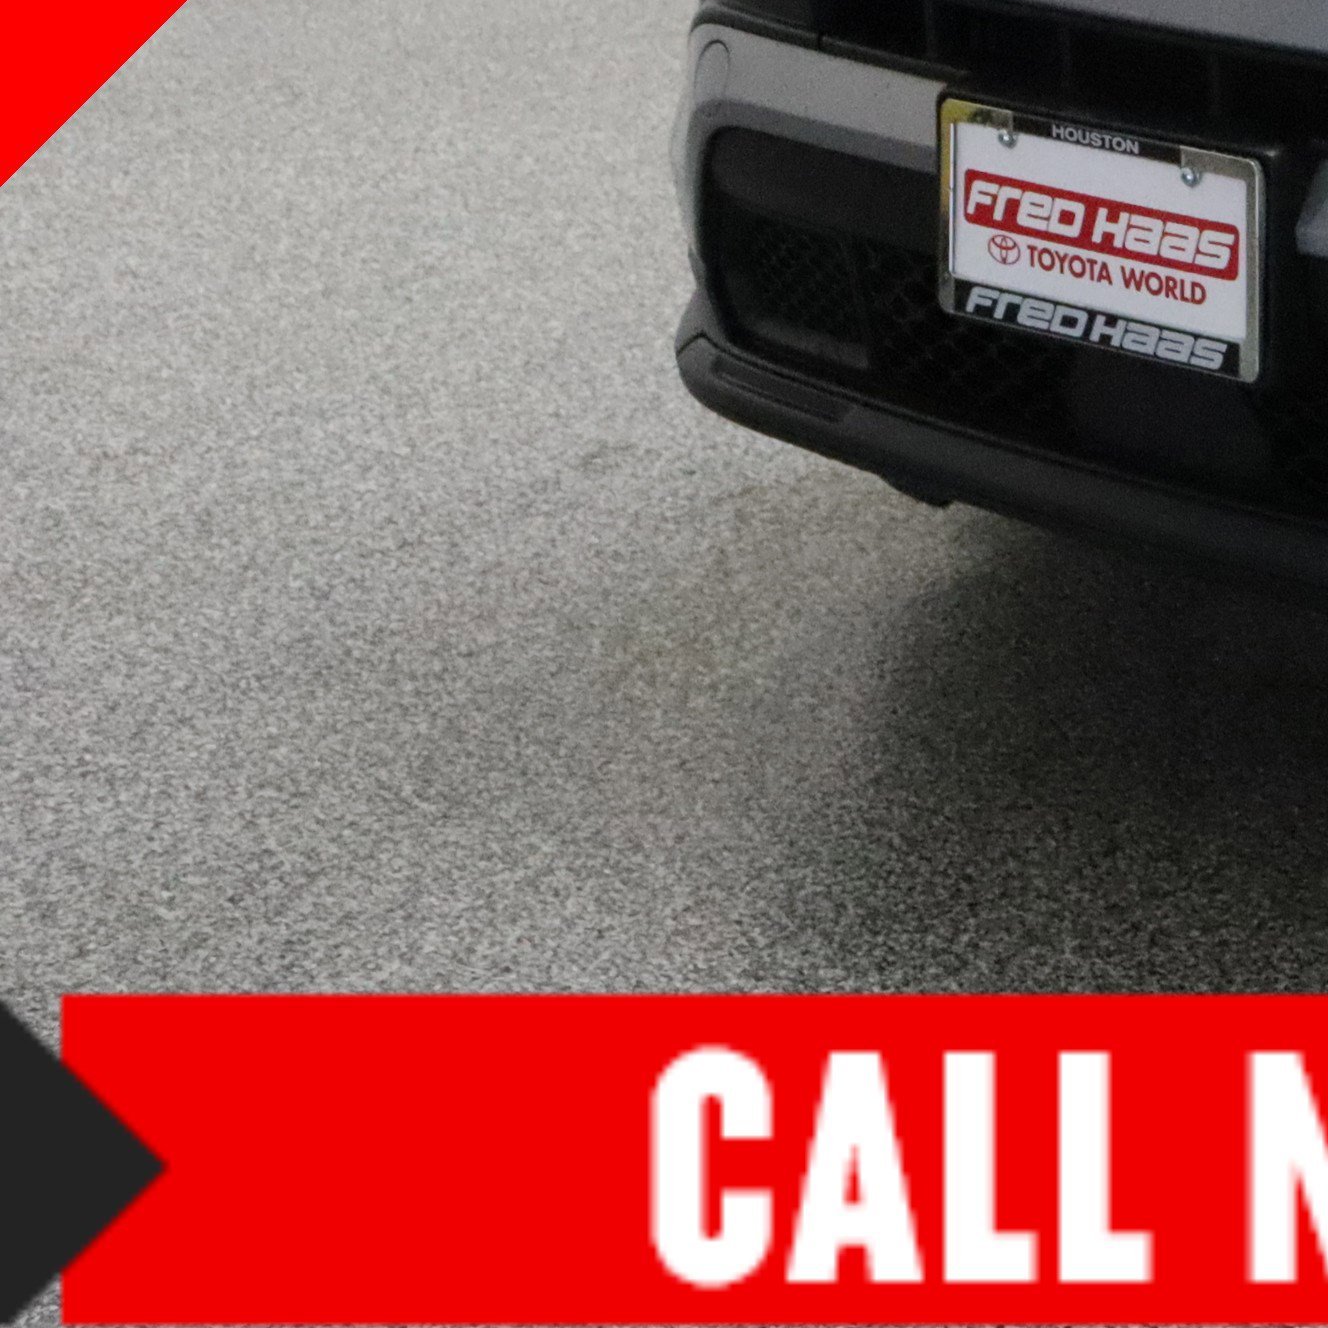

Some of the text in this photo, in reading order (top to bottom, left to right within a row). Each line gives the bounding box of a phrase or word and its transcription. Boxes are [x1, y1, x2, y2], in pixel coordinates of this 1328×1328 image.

[1051, 123, 1140, 155] HOUSTON
[1026, 244, 1208, 305] TOYOTA WORLD
